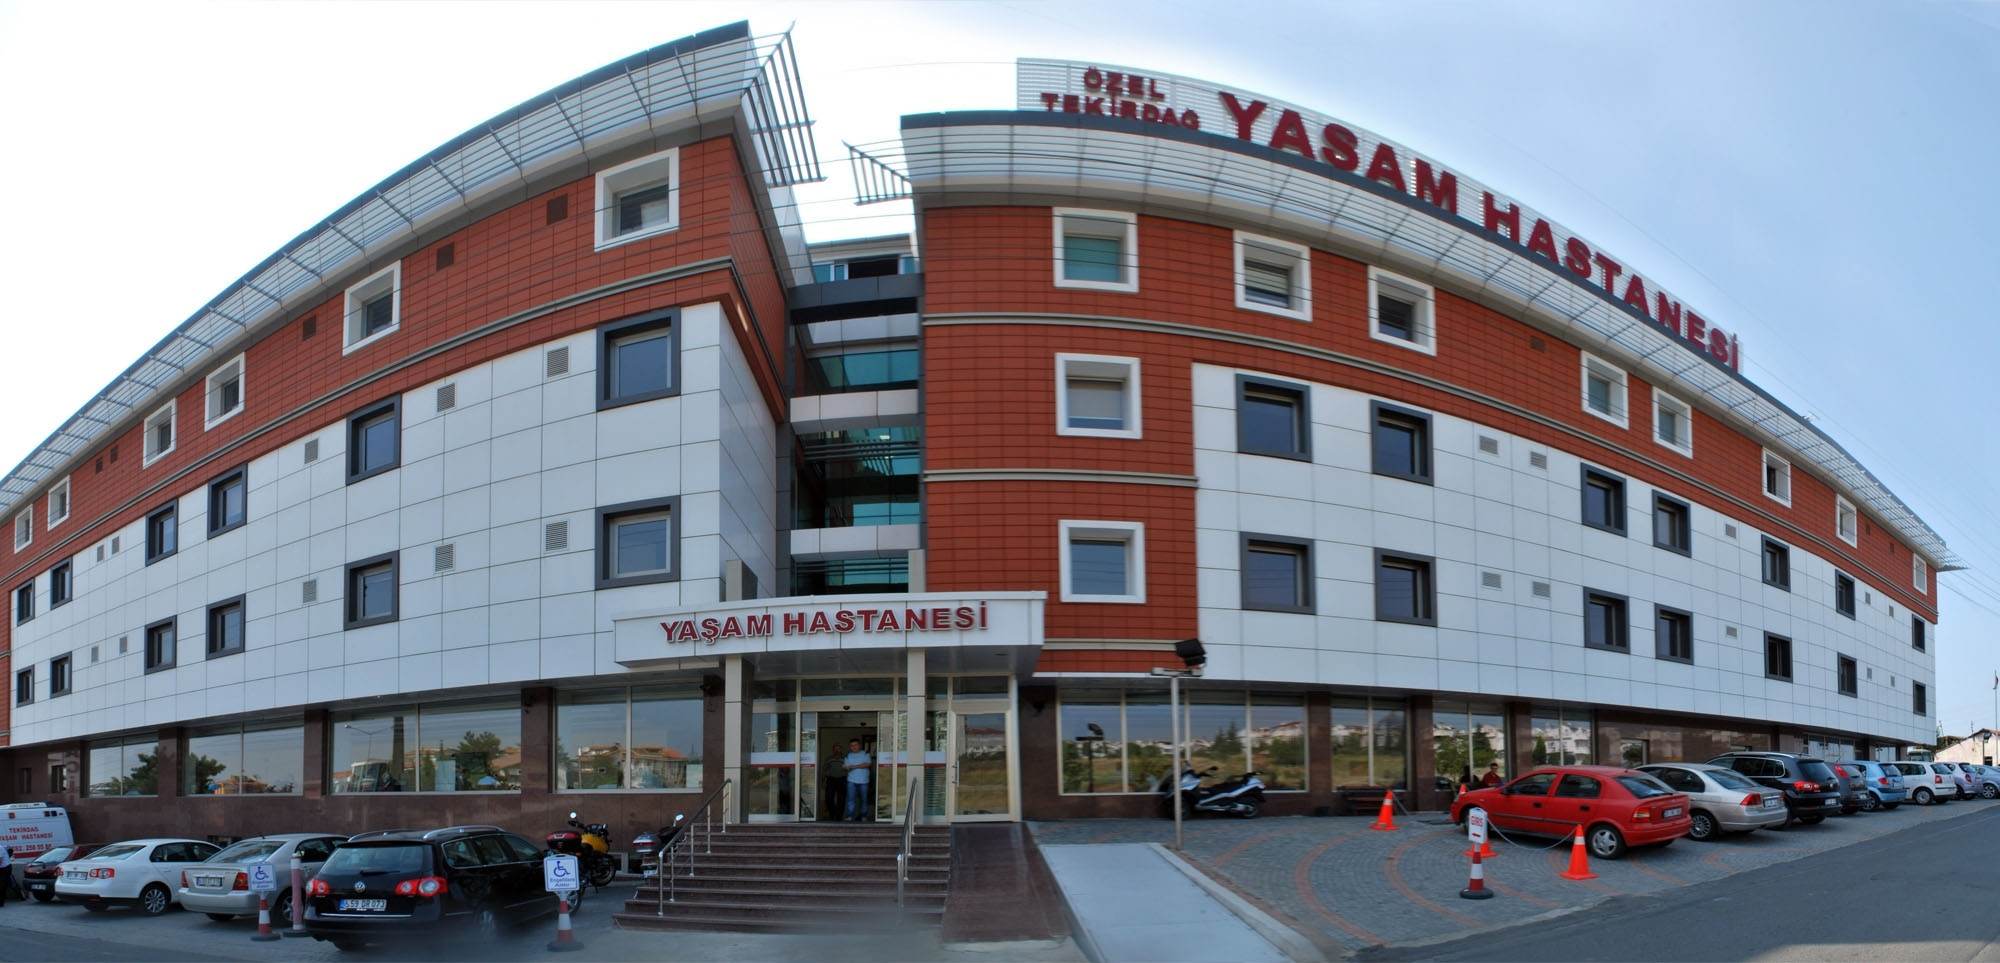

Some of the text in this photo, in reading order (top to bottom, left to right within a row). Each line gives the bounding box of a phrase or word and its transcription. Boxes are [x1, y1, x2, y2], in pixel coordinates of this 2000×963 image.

[1084, 66, 1165, 102] ÖZEL
[1482, 191, 1739, 373] HASTANESİ
[660, 601, 989, 644] YAŞAM HASTANESİ
